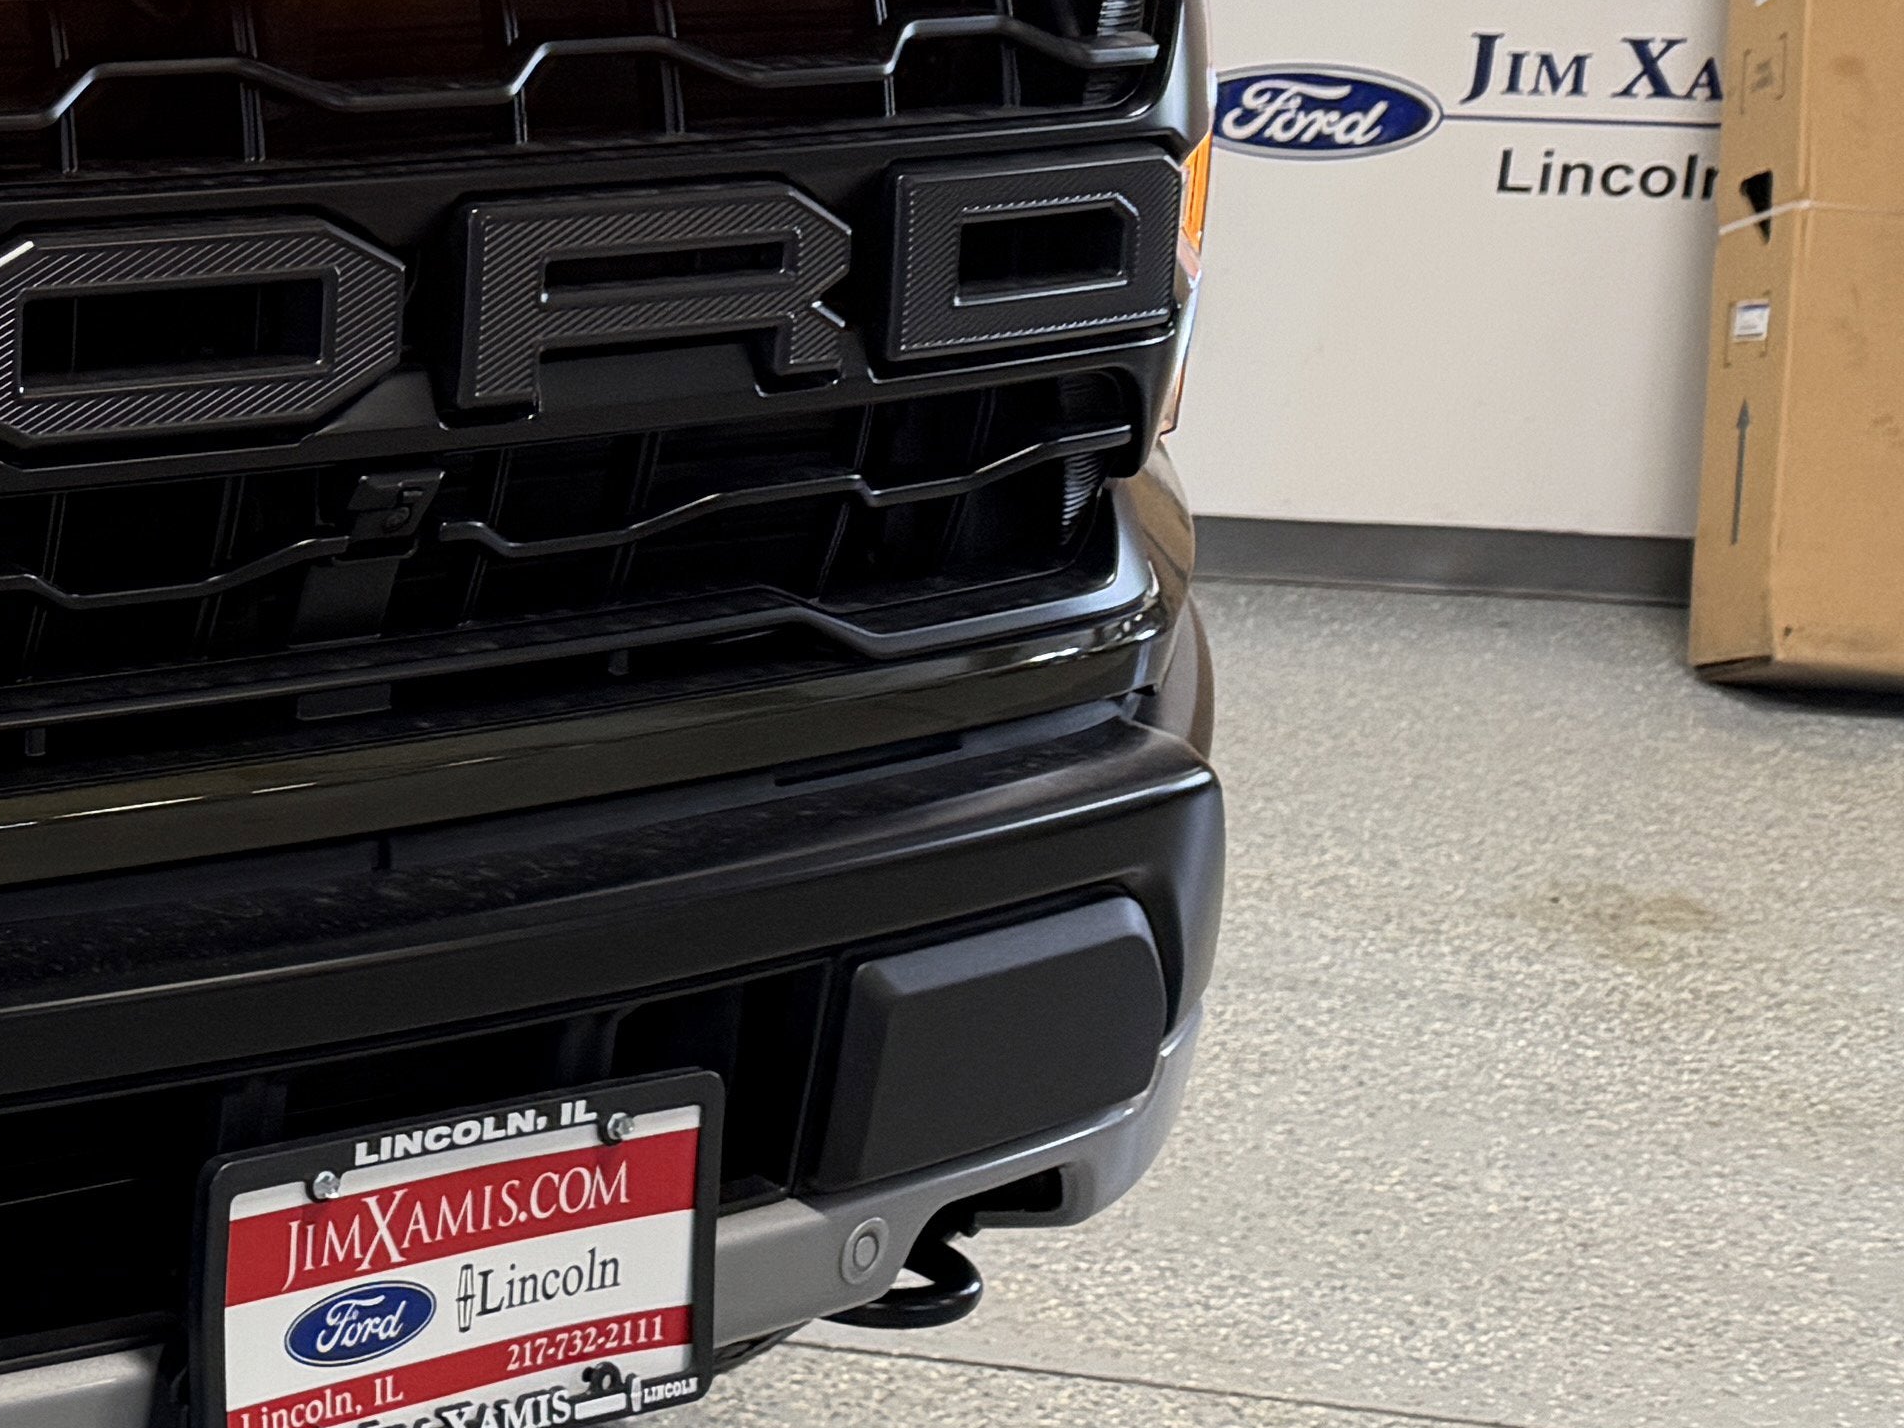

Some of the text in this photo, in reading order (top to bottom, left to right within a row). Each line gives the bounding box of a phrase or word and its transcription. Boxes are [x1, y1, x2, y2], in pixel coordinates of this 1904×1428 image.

[1458, 32, 1593, 106] JIM
[1221, 77, 1388, 146] Ford
[354, 1100, 597, 1166] LINCOLN, IL
[282, 1160, 630, 1291] JIMXAMIS.COM
[475, 1247, 621, 1318] Lincoln
[315, 1296, 405, 1352] Ford
[507, 1315, 665, 1372] 217-732-2111
[374, 1377, 404, 1407] IL
